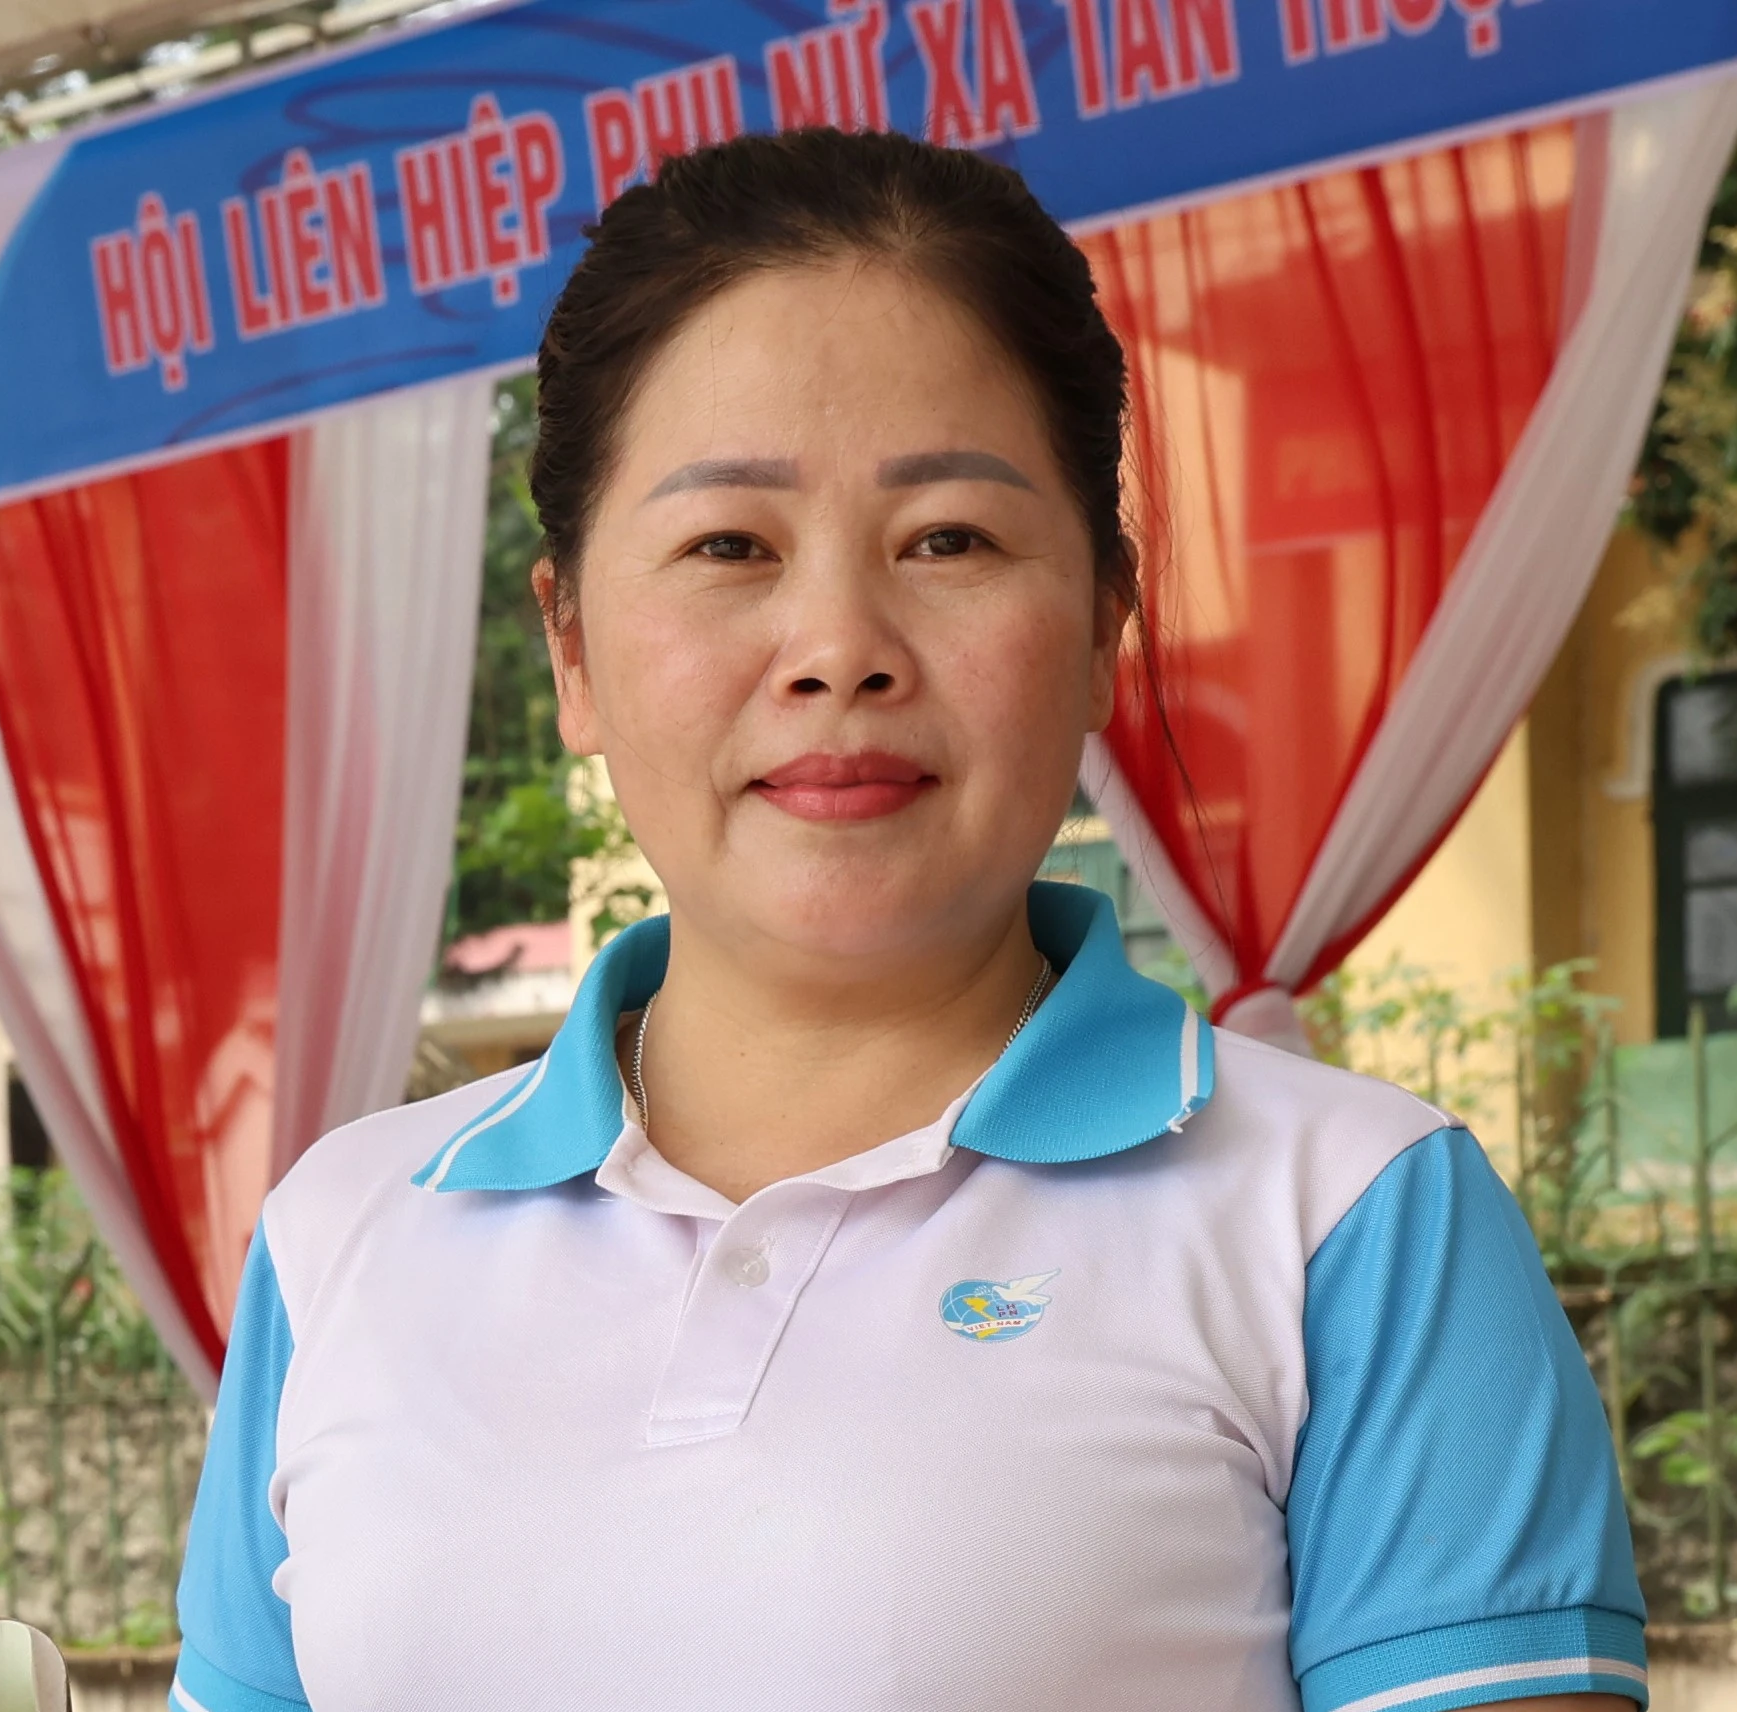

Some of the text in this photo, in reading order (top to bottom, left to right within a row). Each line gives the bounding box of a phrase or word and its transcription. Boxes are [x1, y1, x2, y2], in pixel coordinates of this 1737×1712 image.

[92, 196, 215, 391] HỘI
[224, 149, 385, 341] LIÊN
[398, 94, 565, 304] HIỆP
